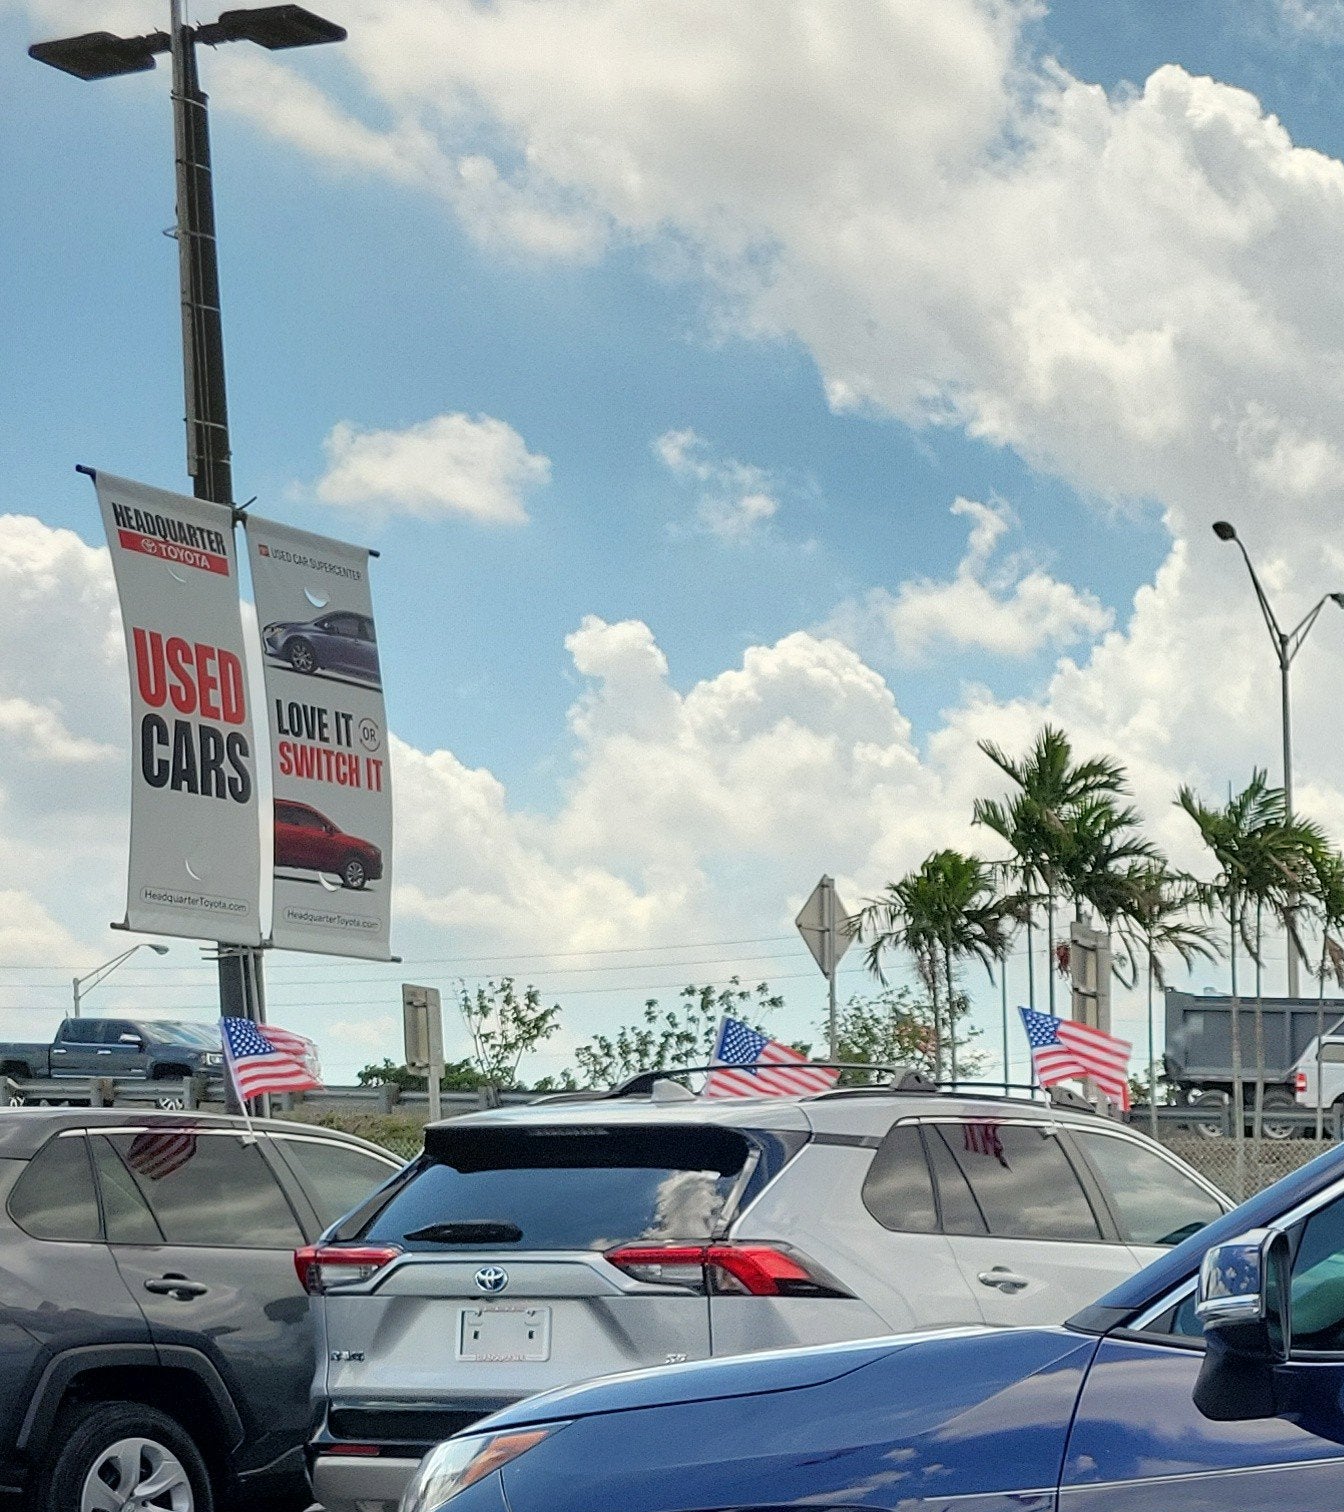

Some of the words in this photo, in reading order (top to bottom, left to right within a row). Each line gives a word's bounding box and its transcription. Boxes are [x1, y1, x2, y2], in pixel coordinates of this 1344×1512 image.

[112, 502, 226, 555] HEADQUARTER
[159, 544, 210, 569] TOYOTA
[271, 548, 292, 563] USED
[293, 554, 309, 567] CAR
[133, 627, 246, 725] USED
[276, 699, 330, 743] LOVE
[335, 711, 353, 748] IT
[362, 727, 376, 741] OR
[141, 713, 252, 804] CARS
[279, 741, 361, 788] SWITCH
[366, 757, 383, 792] IT
[144, 890, 247, 912] HeadquarterToyota.com
[287, 909, 379, 929] HeadquarterToyota.com
